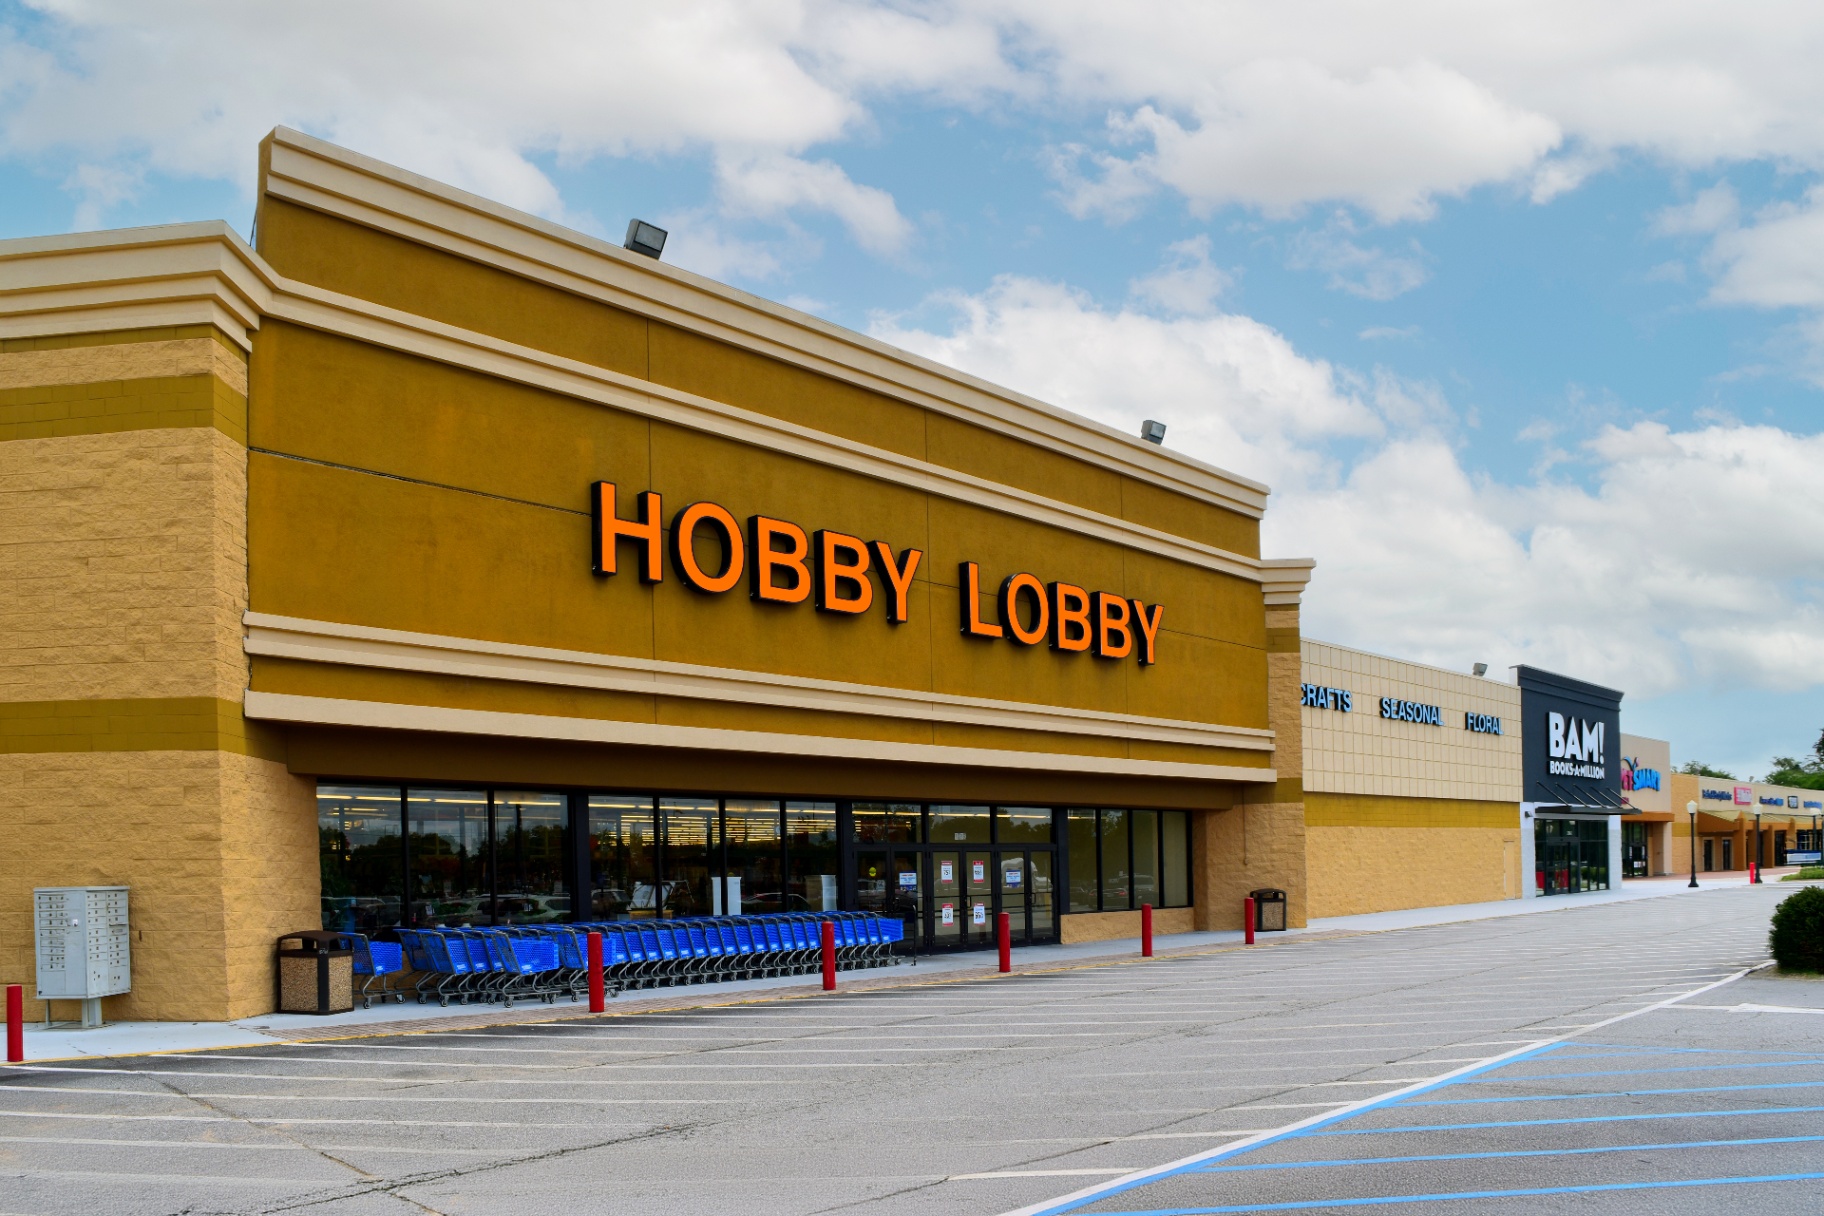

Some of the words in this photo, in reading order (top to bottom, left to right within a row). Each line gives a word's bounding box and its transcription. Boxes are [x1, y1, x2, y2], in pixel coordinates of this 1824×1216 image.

[594, 481, 922, 624] HOBBY
[961, 561, 1164, 665] LOBBY
[1381, 697, 1444, 726] SEASONAL
[1466, 712, 1504, 735] FLORAL
[1548, 711, 1604, 764] BAM!
[1621, 768, 1661, 791] ETSMART
